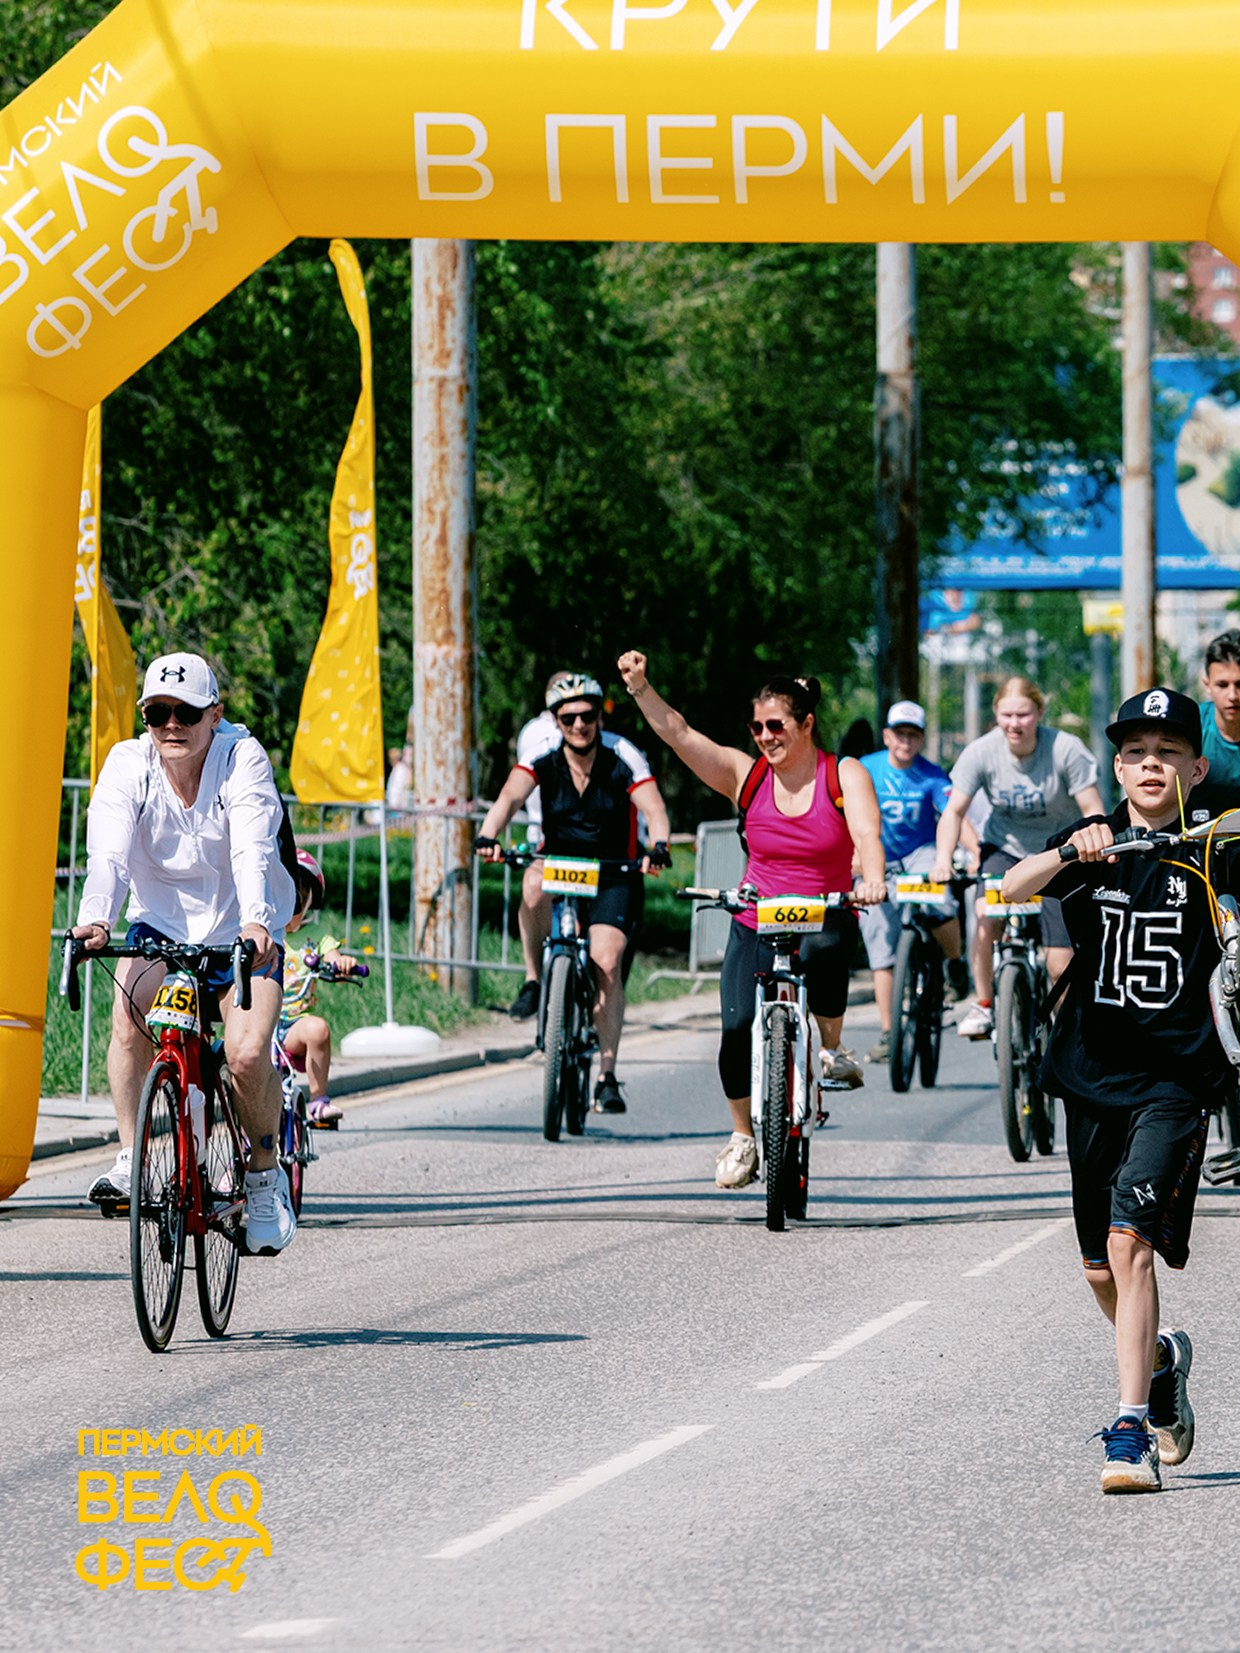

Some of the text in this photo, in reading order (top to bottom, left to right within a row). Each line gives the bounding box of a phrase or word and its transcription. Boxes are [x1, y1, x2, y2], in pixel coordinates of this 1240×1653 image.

[413, 110, 1066, 206] В ПЕРМИ!
[553, 868, 588, 884] 1102
[774, 907, 809, 923] 662
[1094, 905, 1184, 1010] 15
